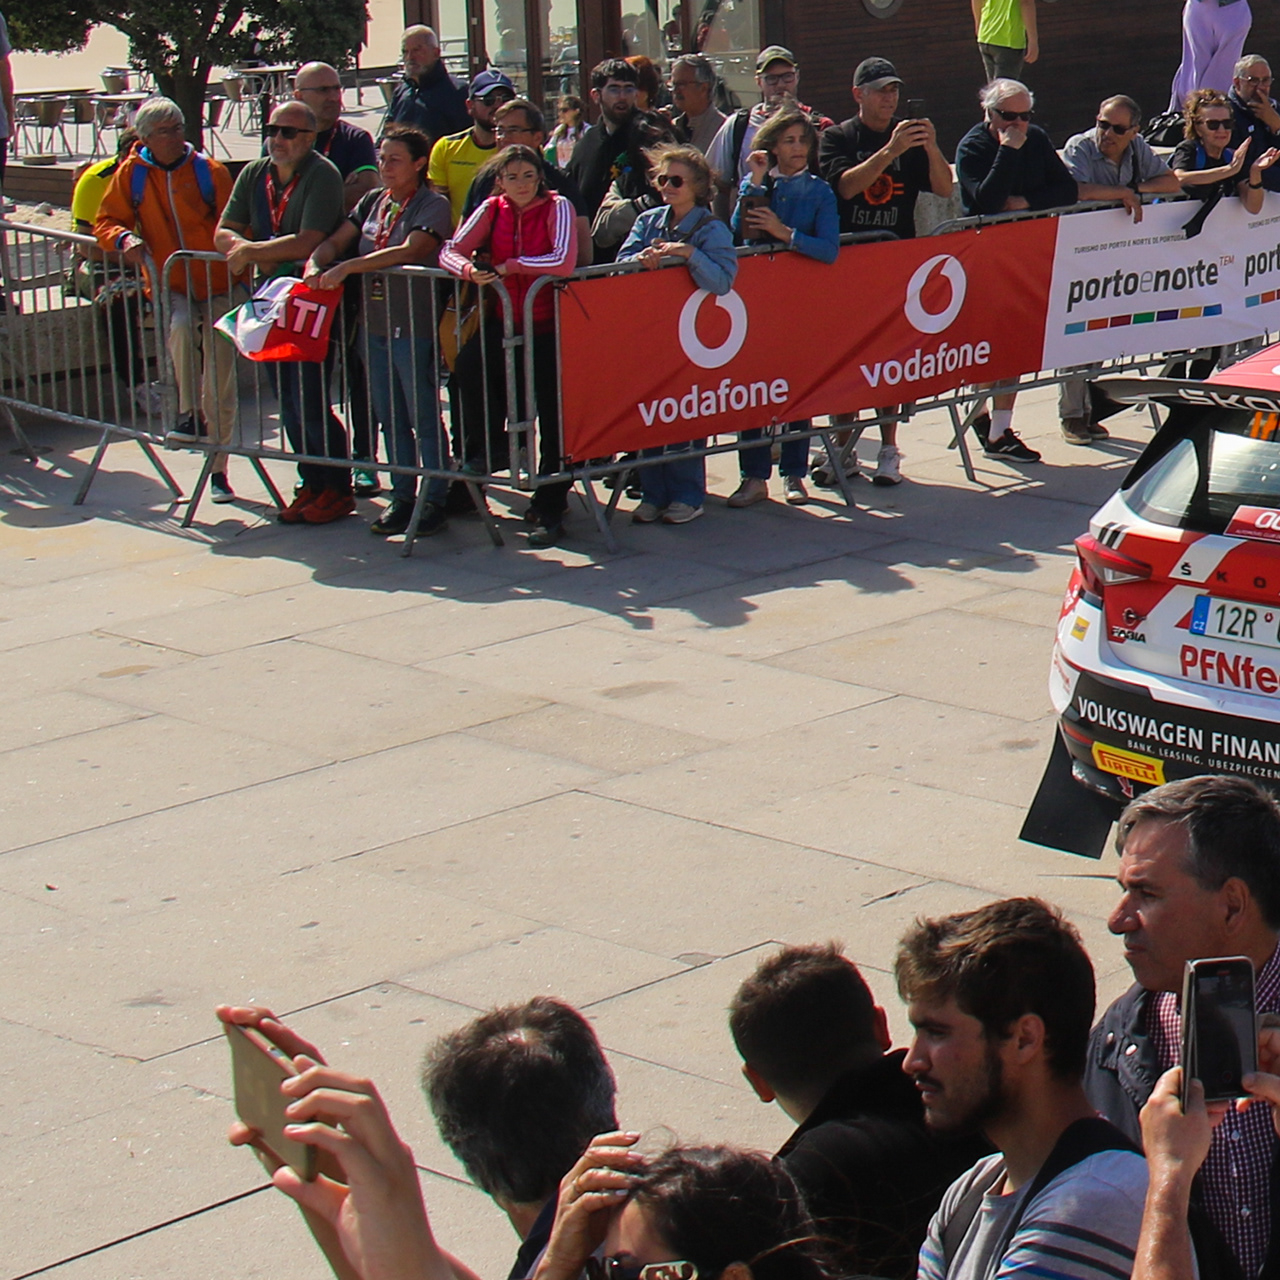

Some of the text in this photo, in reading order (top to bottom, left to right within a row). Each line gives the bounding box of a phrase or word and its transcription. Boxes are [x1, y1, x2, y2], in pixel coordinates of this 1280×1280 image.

[1074, 244, 1099, 254] TURISMO
[1100, 243, 1108, 251] DO
[1108, 240, 1127, 249] PORTO
[1132, 237, 1151, 246] NORTE
[1152, 236, 1159, 244] DE
[1220, 255, 1235, 267] TEM
[860, 340, 991, 388] vodafone
[638, 376, 789, 427] vodafone
[1111, 625, 1147, 643] FABIA
[1193, 620, 1206, 631] CZ
[1215, 604, 1257, 640] 12R
[1078, 694, 1203, 750] VOLKSWAGEN
[1096, 750, 1159, 782] PIRELLI
[1127, 739, 1155, 755] BANK.
[1159, 746, 1203, 766] LEASING.
